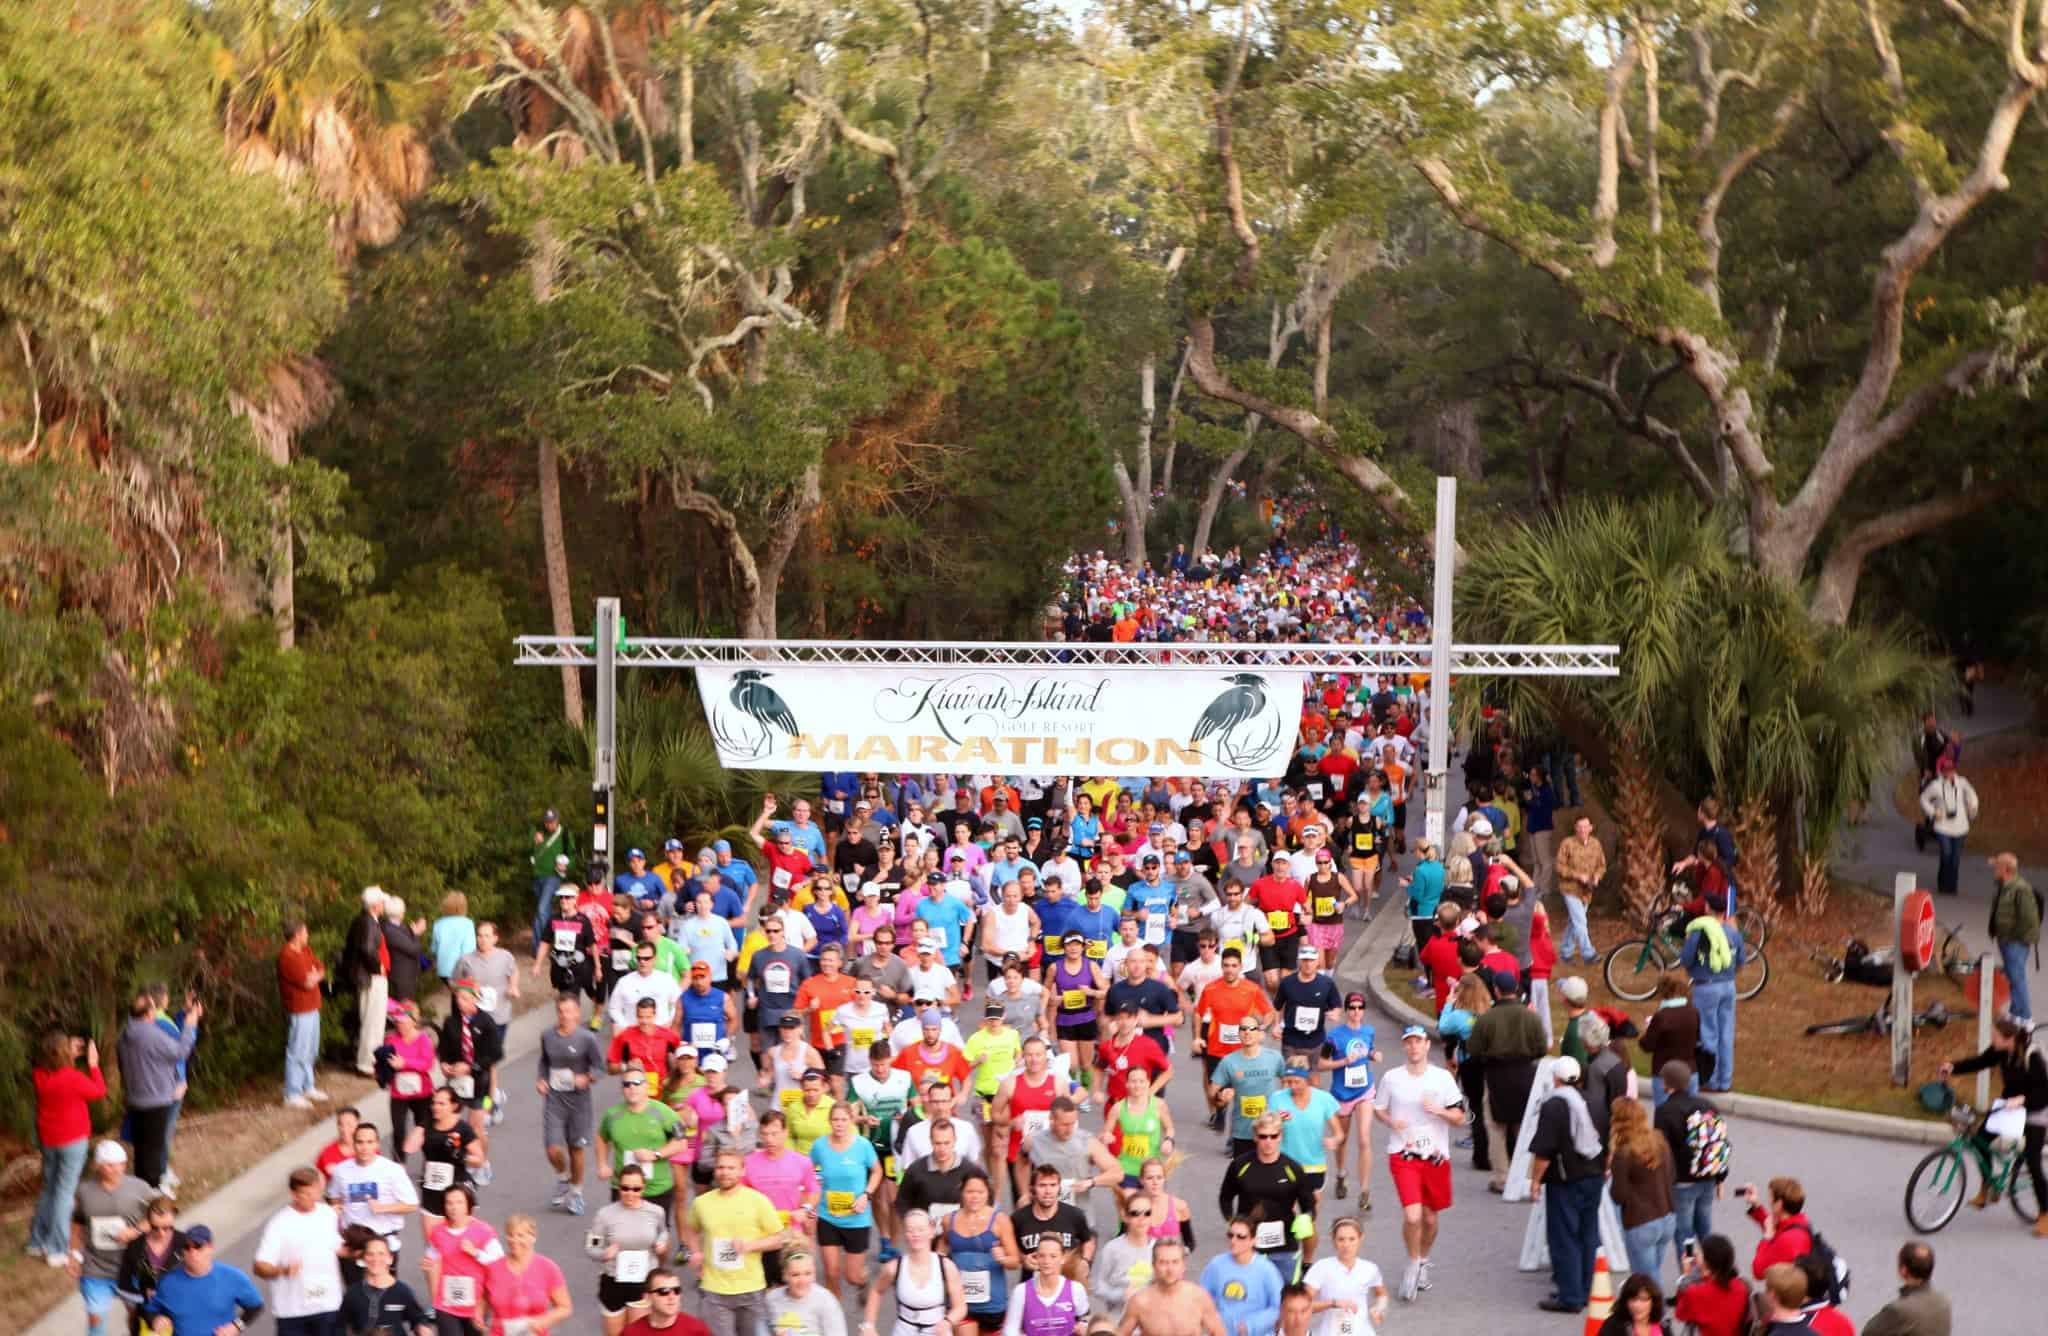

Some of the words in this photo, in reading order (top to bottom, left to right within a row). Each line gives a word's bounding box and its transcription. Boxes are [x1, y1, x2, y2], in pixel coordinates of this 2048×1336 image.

[873, 674, 1006, 746] Kiawah
[1004, 677, 1111, 719] Island
[1001, 720, 1036, 733] GOLF
[1043, 720, 1096, 734] RESORT
[787, 734, 1201, 766] MARATHON
